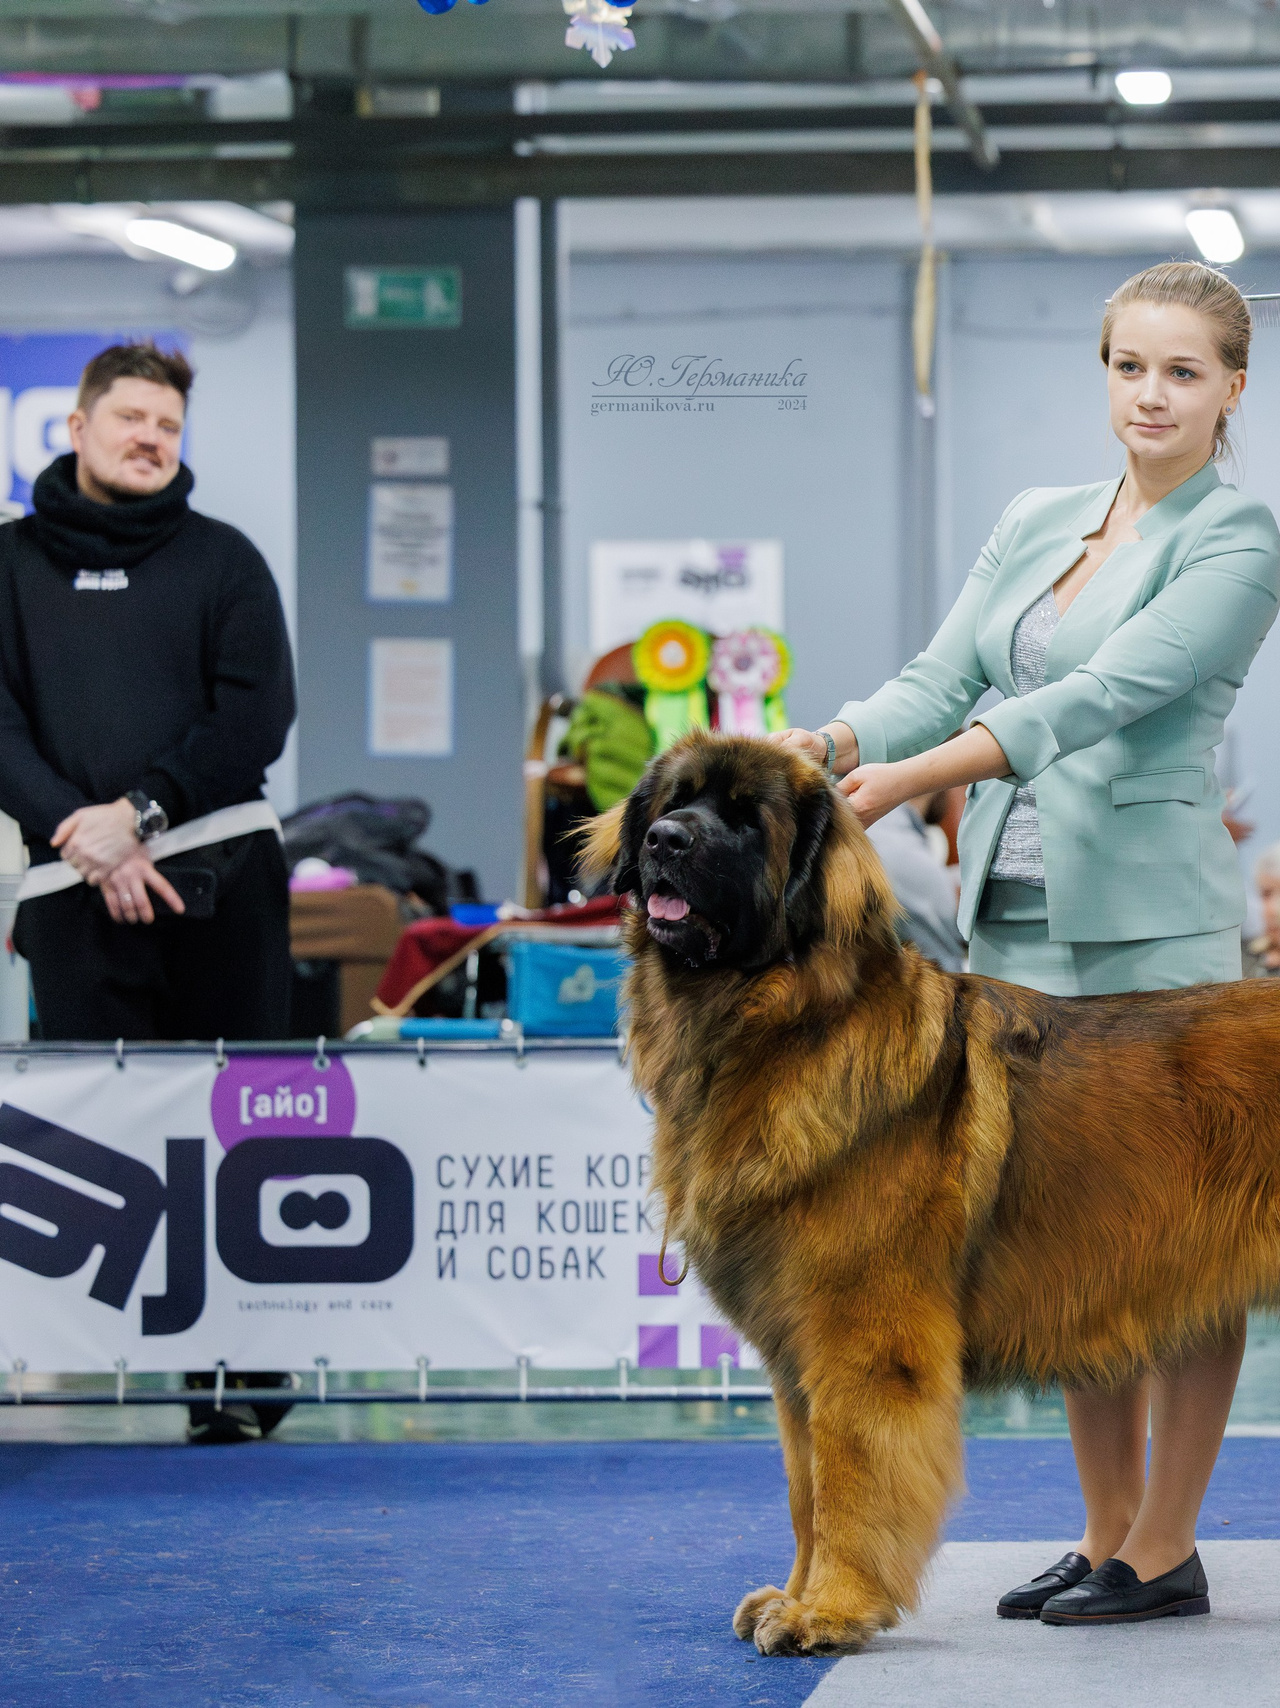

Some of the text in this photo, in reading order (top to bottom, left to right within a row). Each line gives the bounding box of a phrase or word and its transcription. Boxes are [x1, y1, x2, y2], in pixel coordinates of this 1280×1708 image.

[436, 1154, 554, 1188] СУХИЕ
[435, 1200, 655, 1241] ДЛЯ КОШЕК
[437, 1246, 606, 1280] И СОБАК
